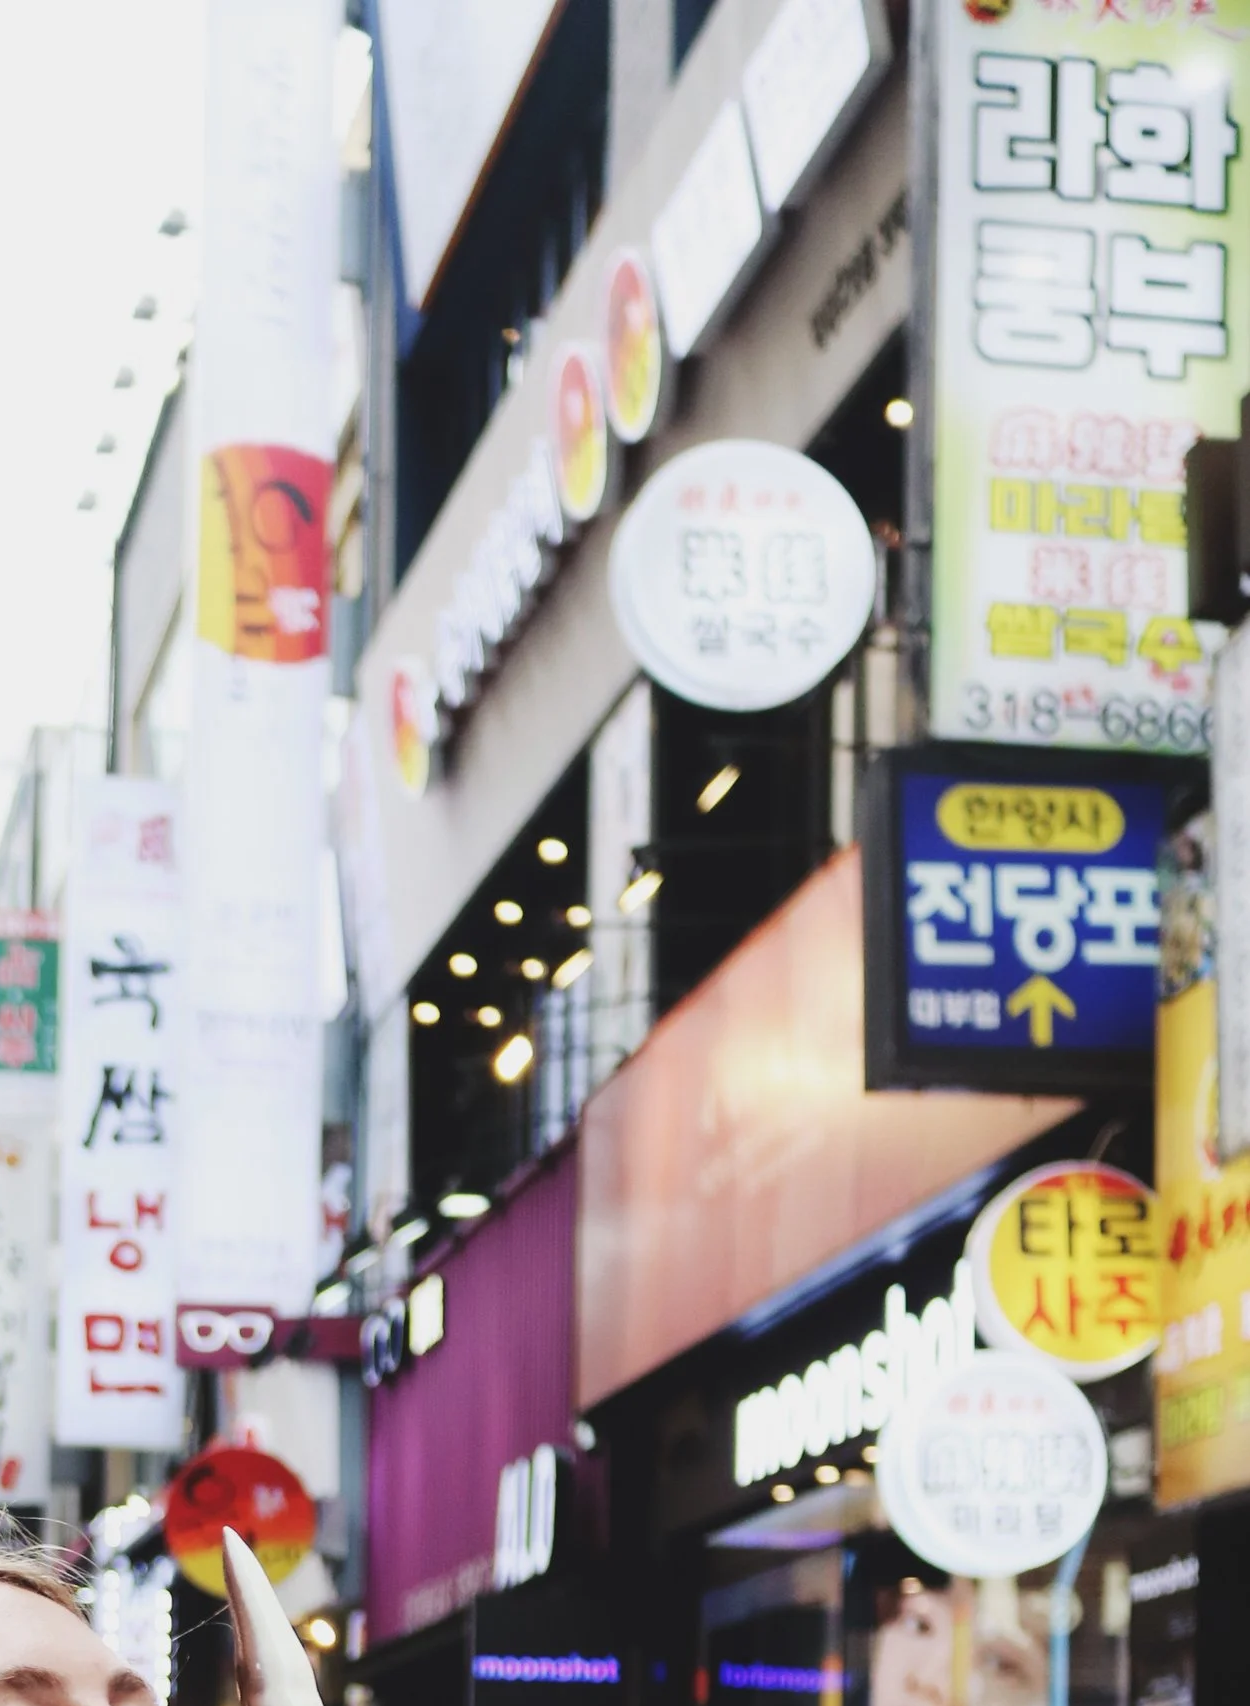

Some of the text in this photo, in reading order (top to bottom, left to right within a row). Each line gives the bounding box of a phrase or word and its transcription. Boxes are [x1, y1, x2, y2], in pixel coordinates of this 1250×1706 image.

[973, 50, 1241, 214] 라화
[987, 604, 1203, 673] 쌀국수
[963, 684, 1214, 749] 318-686
[906, 861, 1161, 974] 전당포
[1018, 1194, 1161, 1259] 타로
[1022, 1273, 1160, 1337] 사주
[735, 1257, 976, 1487] moonshot
[473, 1654, 620, 1682] moonshot
